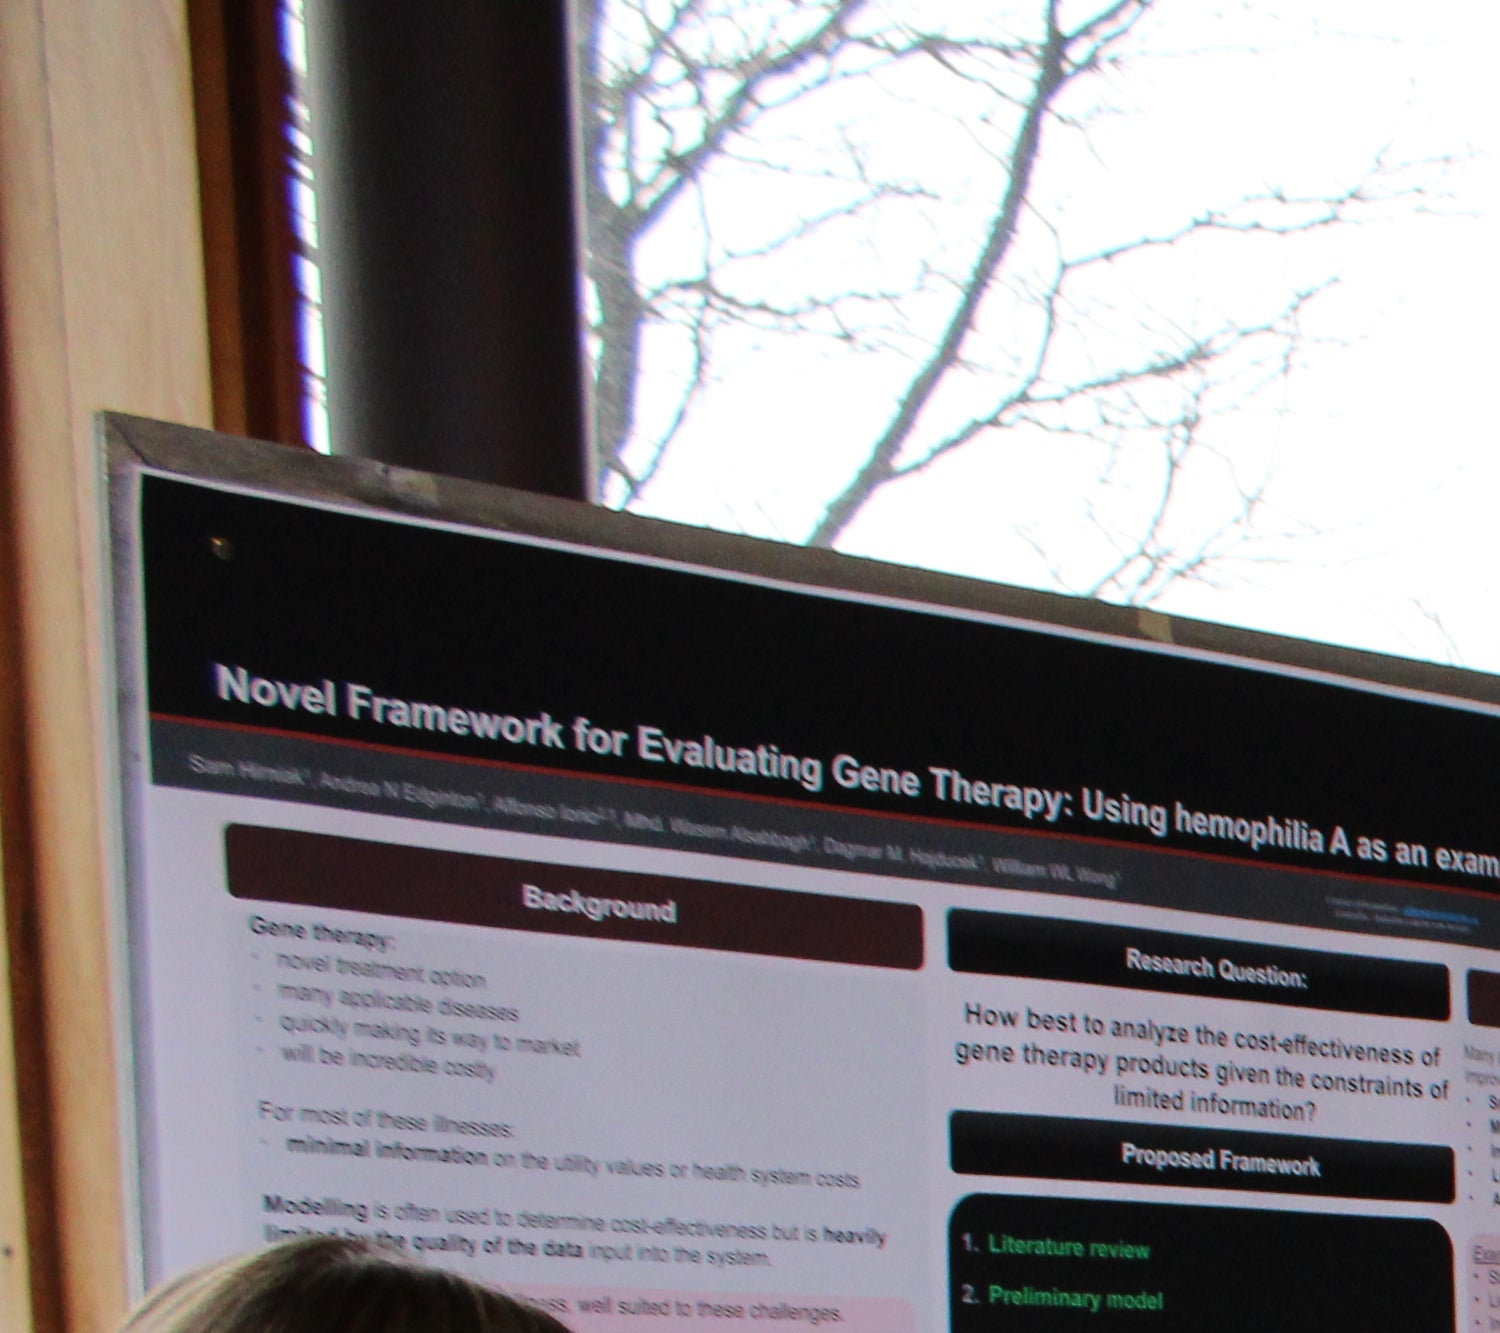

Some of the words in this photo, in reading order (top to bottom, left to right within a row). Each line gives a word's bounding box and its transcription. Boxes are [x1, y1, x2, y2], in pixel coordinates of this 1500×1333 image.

[213, 662, 336, 716] Novel
[346, 682, 565, 750] Framework
[571, 715, 629, 758] for
[637, 724, 823, 790] Evaluating
[831, 752, 921, 798] Gene
[928, 765, 1072, 825] Therapy:
[1081, 785, 1168, 838] Using
[1174, 800, 1324, 859] hemophilia
[1329, 824, 1352, 857] A
[1356, 835, 1388, 863] as
[1394, 840, 1428, 868] an
[522, 883, 676, 927] Background
[249, 914, 307, 940] Gene
[1126, 946, 1215, 978] Research
[1218, 957, 1307, 990] Question:
[965, 1002, 1018, 1028] How
[1027, 1007, 1076, 1033] best
[1082, 1014, 1104, 1036] to
[1110, 1016, 1188, 1049] analyze
[1195, 1024, 1228, 1047] the
[1234, 1028, 1414, 1065] cost-effectiveness
[1421, 1045, 1440, 1067] of
[955, 1041, 1014, 1069] gene
[1022, 1042, 1108, 1076] therapy
[1116, 1050, 1209, 1082] products
[1215, 1059, 1269, 1089] given
[1275, 1065, 1305, 1088] the
[1310, 1070, 1423, 1098] constraints
[1429, 1078, 1448, 1100] of
[1114, 1084, 1183, 1111] limited
[1191, 1090, 1316, 1122] information?
[1121, 1141, 1216, 1173] Proposed
[1219, 1148, 1321, 1177] Framework
[962, 1232, 978, 1251] 1.
[988, 1233, 1085, 1256] Literature
[1089, 1239, 1150, 1259] review
[962, 1283, 979, 1304] 2.
[988, 1284, 1101, 1312] Preliminary
[1106, 1290, 1163, 1310] model
